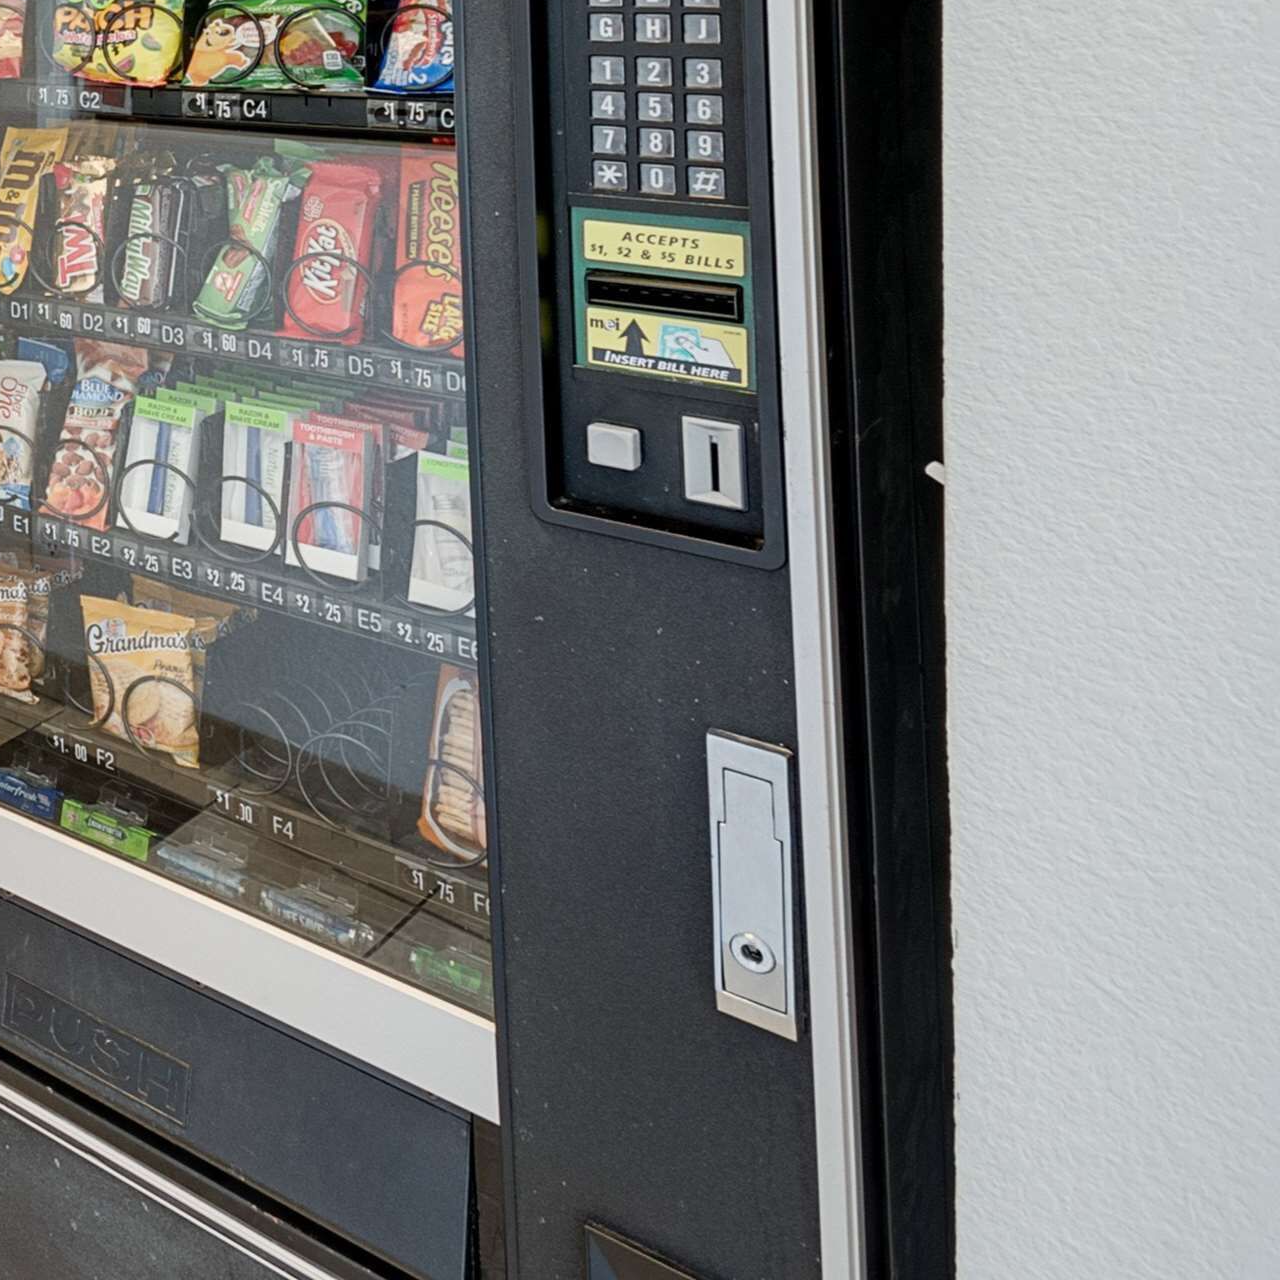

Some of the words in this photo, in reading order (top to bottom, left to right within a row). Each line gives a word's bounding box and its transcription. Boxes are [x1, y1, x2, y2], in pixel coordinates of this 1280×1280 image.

[599, 18, 613, 37] G
[646, 19, 660, 38] H
[698, 19, 707, 39] J
[602, 61, 611, 80] 1
[647, 62, 661, 82] 2
[696, 63, 709, 84] 3
[80, 90, 101, 108] C2
[243, 99, 267, 118] C4
[601, 95, 614, 115] 4
[649, 97, 661, 117] 5
[697, 99, 711, 119] 6
[603, 130, 614, 149] 7
[649, 133, 662, 152] 8
[698, 135, 712, 156] 9
[650, 168, 663, 188] 0
[622, 231, 700, 250] ACCEPTS
[617, 246, 632, 259] $2
[641, 250, 652, 261] &
[661, 252, 676, 264] $5
[685, 254, 735, 270] BILLS
[10, 302, 28, 319] D1
[82, 314, 103, 332] D2
[162, 326, 184, 345] D3
[248, 340, 273, 360] D4
[349, 355, 375, 377] D5
[605, 349, 653, 370] INSERT
[657, 358, 688, 375] BILL
[691, 364, 730, 381] HERE
[81, 379, 111, 393] BLUE
[73, 407, 109, 417] BOLD
[14, 514, 30, 534] E1
[92, 537, 110, 557] E2
[172, 557, 193, 579] E3
[261, 583, 284, 605] E4
[358, 609, 382, 632] E5
[87, 623, 189, 654] Grandma's
[97, 748, 115, 770] F2
[272, 816, 293, 840] F4
